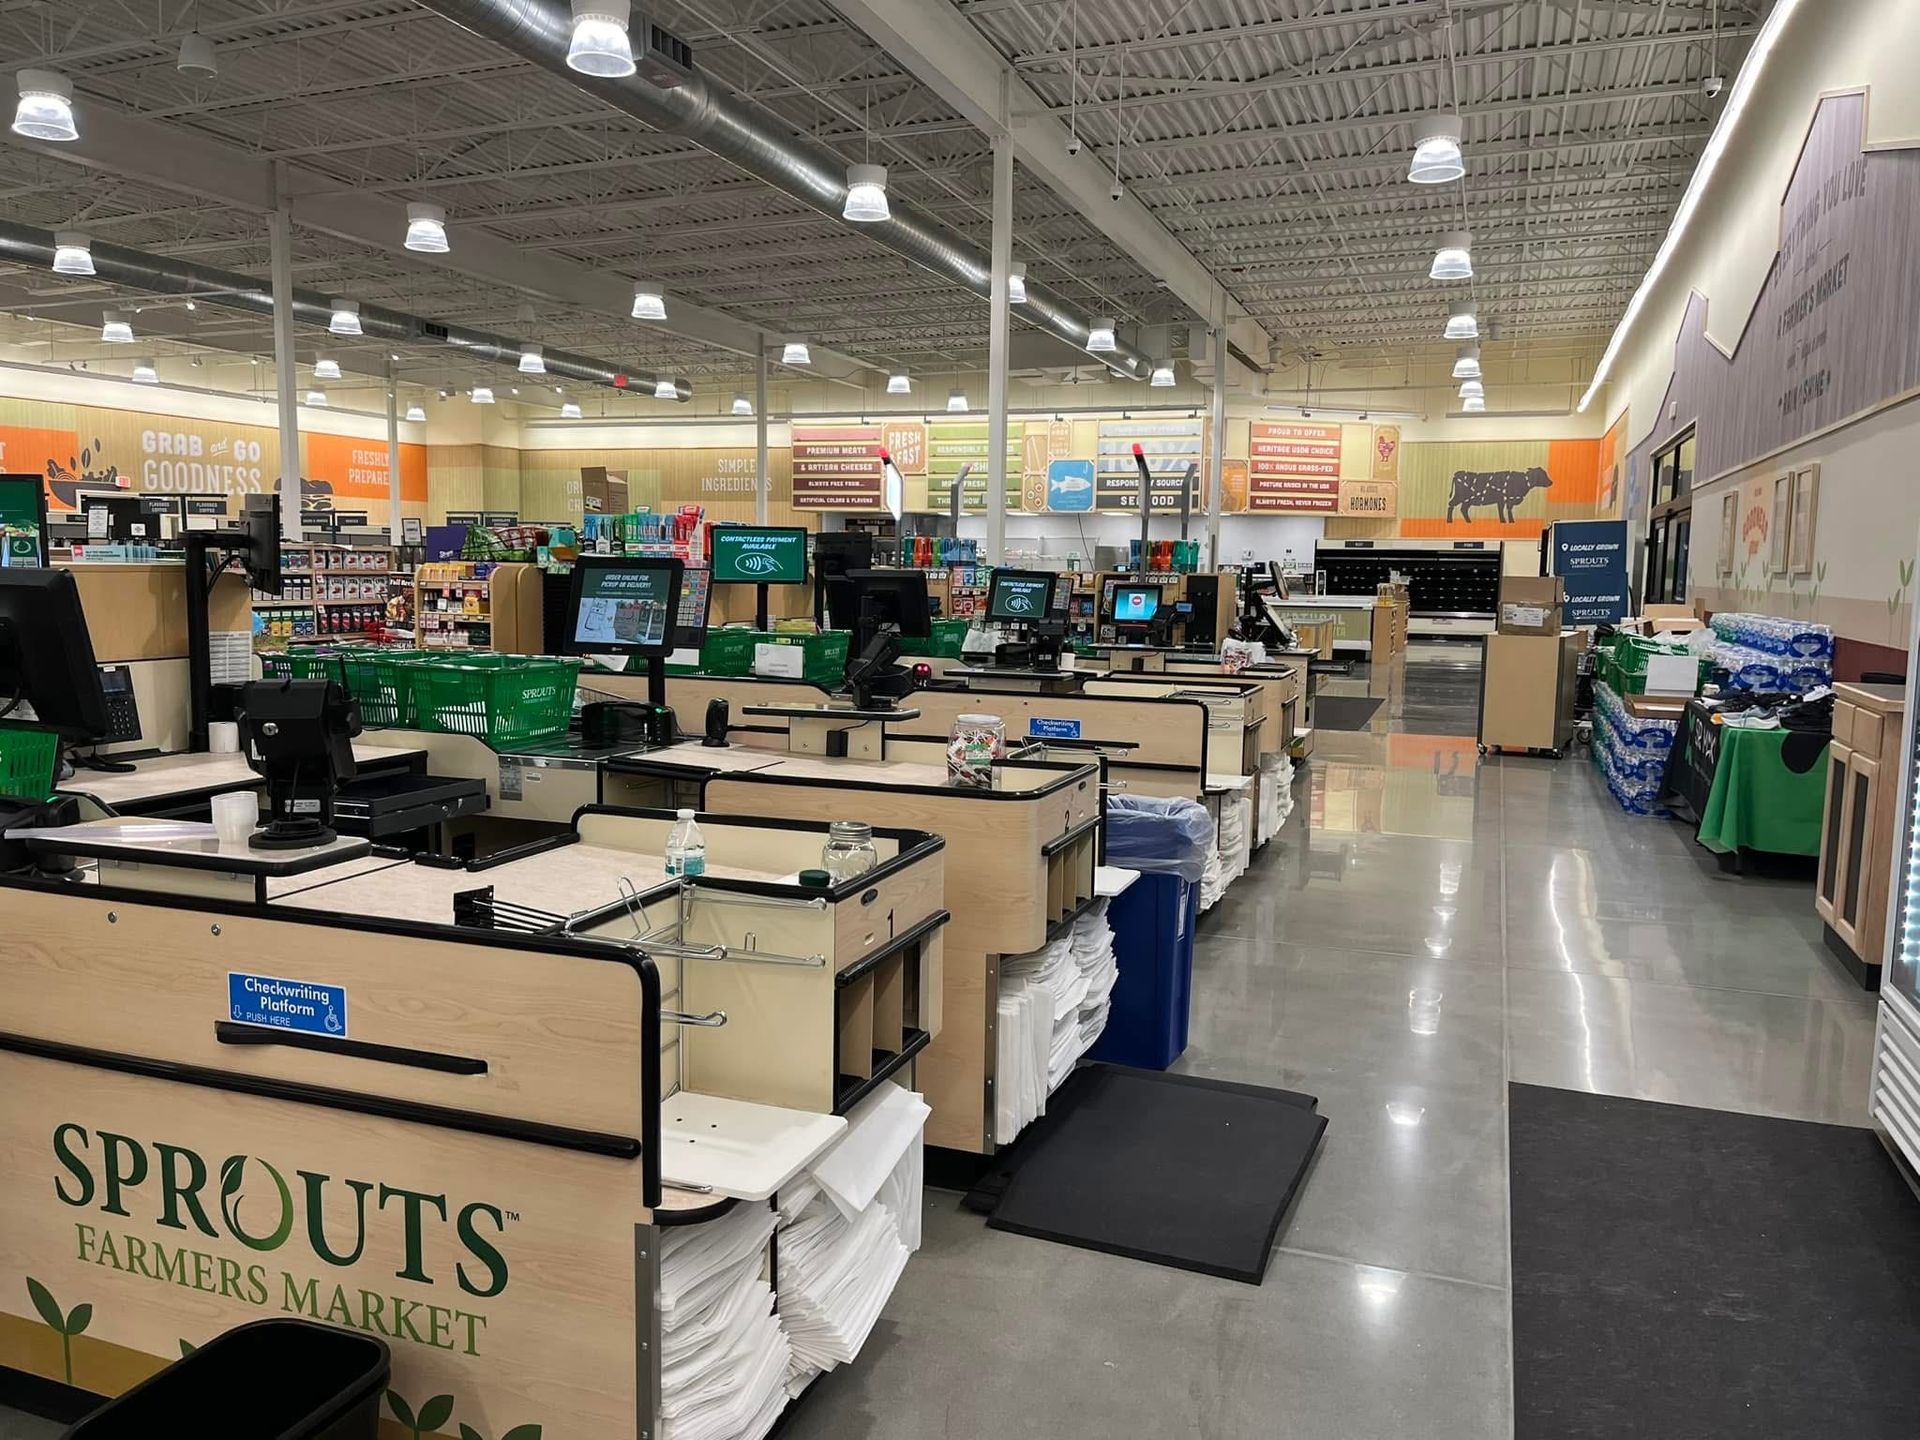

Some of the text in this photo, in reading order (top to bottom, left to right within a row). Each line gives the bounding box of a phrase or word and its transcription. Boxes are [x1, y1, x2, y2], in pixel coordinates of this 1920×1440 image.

[1823, 170, 1840, 215] YOU
[1842, 154, 1867, 201] LOVE
[1816, 252, 1850, 308] MARKET
[142, 430, 261, 462] GRAB and GO
[889, 432, 922, 451] FRESH
[352, 449, 390, 467] FRESHLY
[897, 445, 921, 465] FAST
[718, 458, 756, 473] SIMPLE
[144, 459, 261, 496] GOODNESS
[348, 468, 390, 486] PREPARE
[702, 476, 773, 492] INGREDIENS
[964, 480, 986, 488] FRESH
[1120, 496, 1174, 506] SEOOD
[1350, 497, 1386, 511] HORMONES
[1570, 544, 1595, 552] LOCALLY
[1570, 557, 1609, 565] SPROUTS
[1572, 608, 1610, 616] SPROUTS
[522, 686, 556, 700] SPROUTS
[888, 908, 894, 939] 1
[244, 978, 330, 1005] Checkwriting
[260, 996, 314, 1016] Platform
[246, 1012, 290, 1026] PUSH HERE
[52, 1122, 509, 1298] SPROUTS
[75, 1222, 487, 1357] FARMERS MARKET
